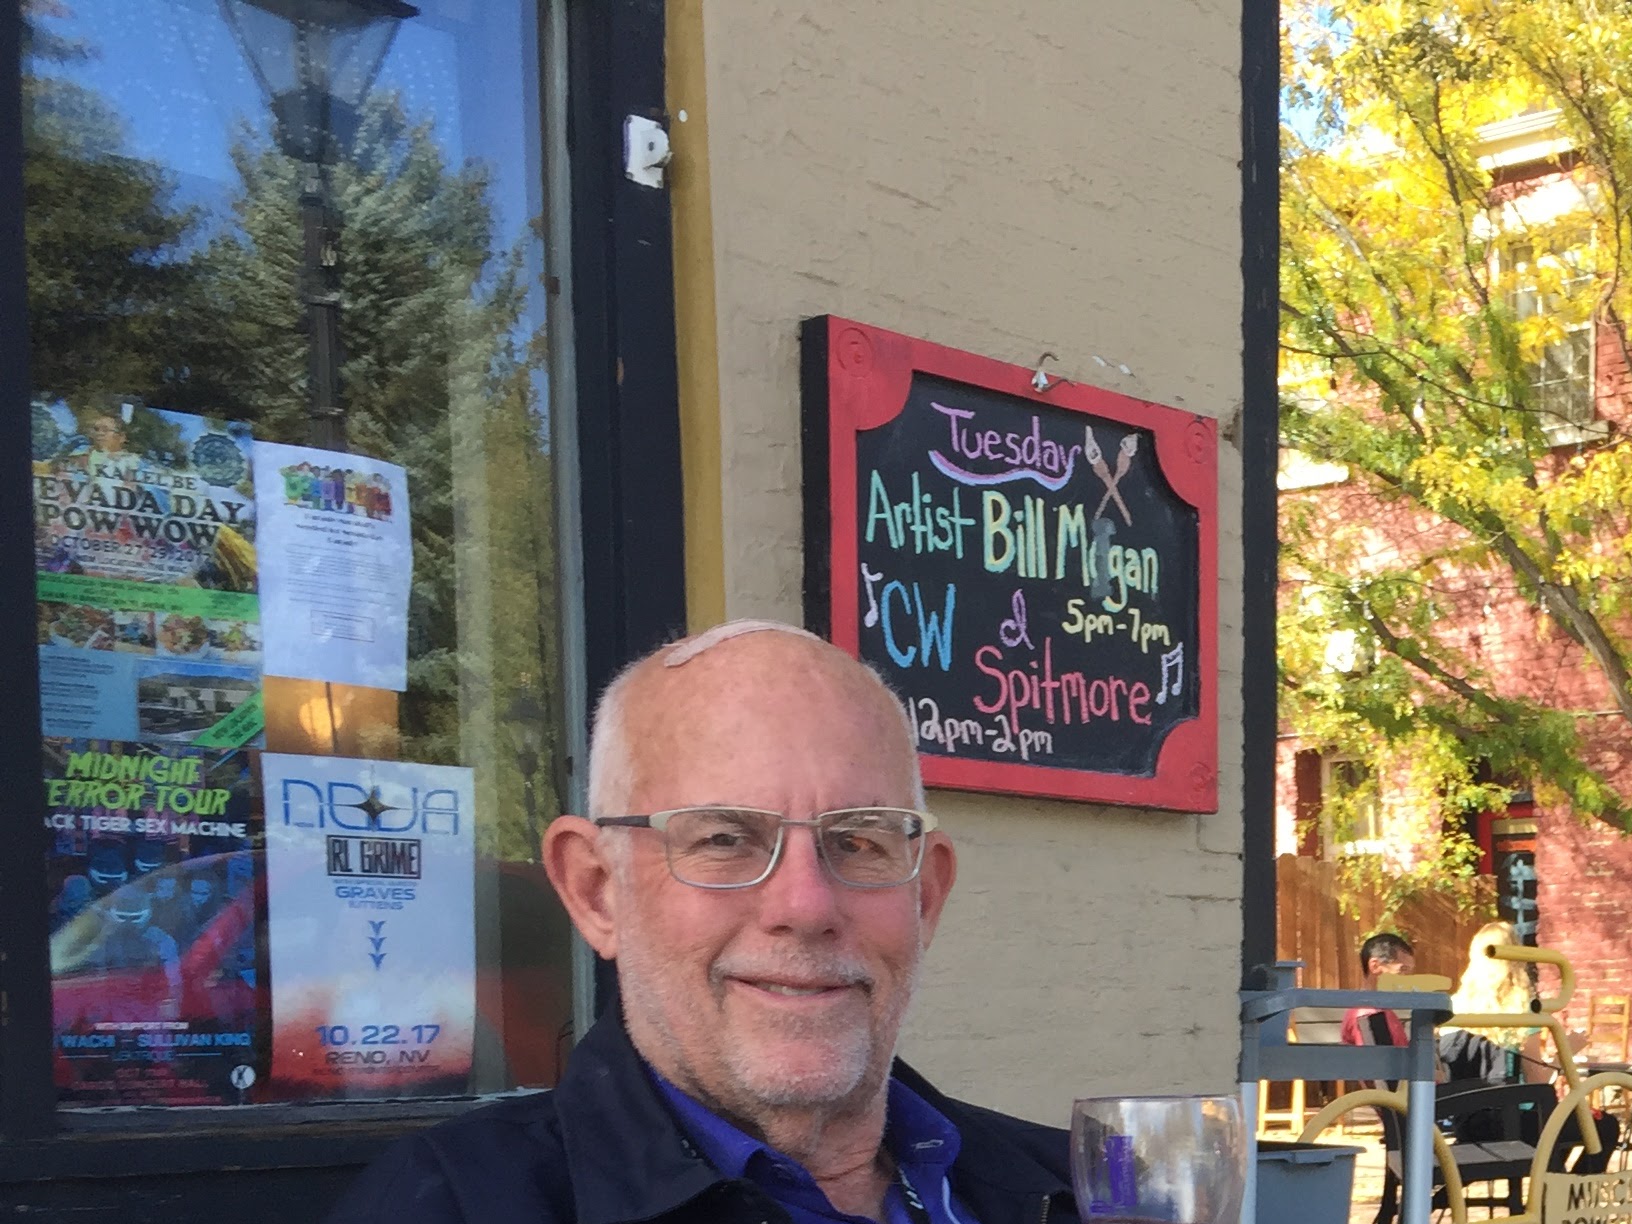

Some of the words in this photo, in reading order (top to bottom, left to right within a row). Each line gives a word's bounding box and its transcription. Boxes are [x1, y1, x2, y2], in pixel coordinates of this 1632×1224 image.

[930, 401, 1081, 473] Tuesday
[34, 476, 165, 515] EVADA
[172, 494, 245, 524] DAY
[172, 476, 198, 490] BE
[39, 503, 121, 534] POW
[129, 515, 219, 549] WOW
[865, 469, 976, 560] Artist
[982, 490, 1048, 580] Bill
[880, 579, 956, 672] CW
[1061, 598, 1172, 654] 5pm-7pm
[973, 636, 1152, 735] Spitmore
[909, 697, 1053, 761] 12pm-2pm
[66, 751, 204, 785] MIDNIGHT
[44, 778, 145, 811] ERROR
[155, 785, 231, 815] TOUR
[80, 814, 132, 832] TIGER
[134, 818, 168, 834] SEX
[170, 821, 247, 838] MACHINE
[332, 839, 352, 873] RL
[360, 840, 418, 875] GRIME
[335, 885, 416, 901] GRAVES
[315, 1024, 440, 1046] 10.22.17
[326, 1051, 390, 1065] RENO,
[400, 1051, 431, 1063] NV
